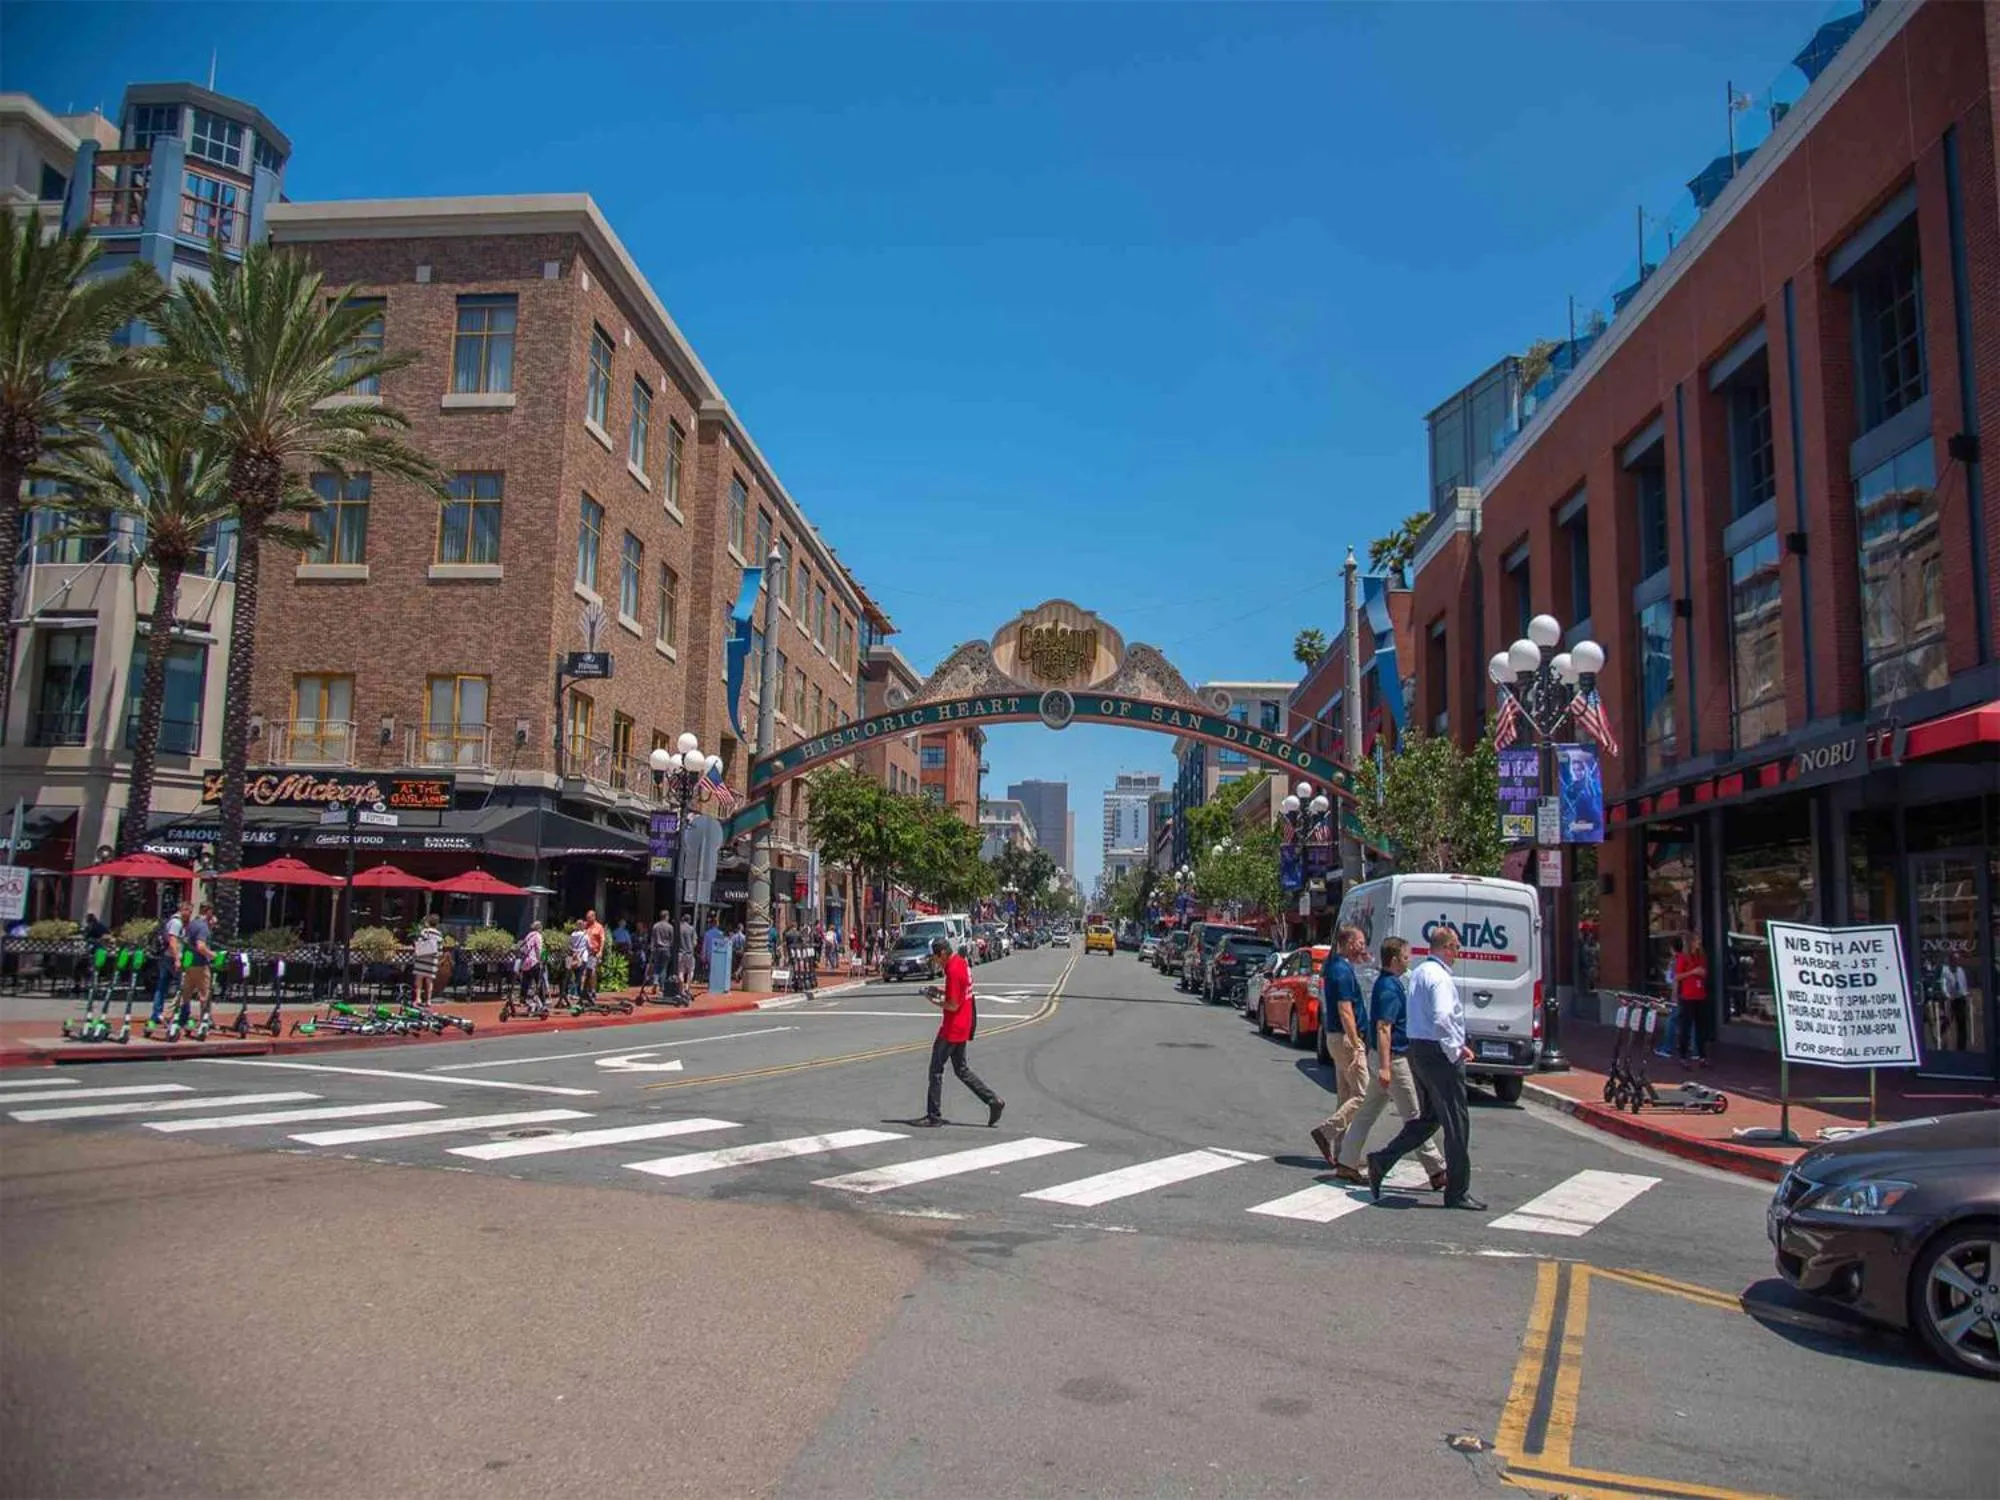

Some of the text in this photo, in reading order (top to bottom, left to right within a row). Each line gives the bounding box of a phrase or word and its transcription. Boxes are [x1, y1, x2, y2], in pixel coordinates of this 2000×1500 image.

[803, 697, 1311, 768] HISTORIC HEART OF SAN DIEGO
[1800, 739, 1855, 774] NOBU
[1784, 936, 1885, 955] N/B 5TH AVE
[1793, 955, 1840, 970] HARBOR
[1851, 960, 1858, 969] J
[1862, 958, 1877, 968] ST
[1798, 970, 1877, 989] CLOSED
[1813, 994, 1832, 1006] JULY
[1787, 1004, 1825, 1019] THUR-SAT
[1855, 1007, 1902, 1020] 7AM-10PM
[1795, 1020, 1814, 1032] SUN
[1816, 1022, 1835, 1035] JULY
[1851, 1023, 1896, 1035] 7AM-8PM
[1795, 1042, 1902, 1057] FOR SPECIAL EVENT
